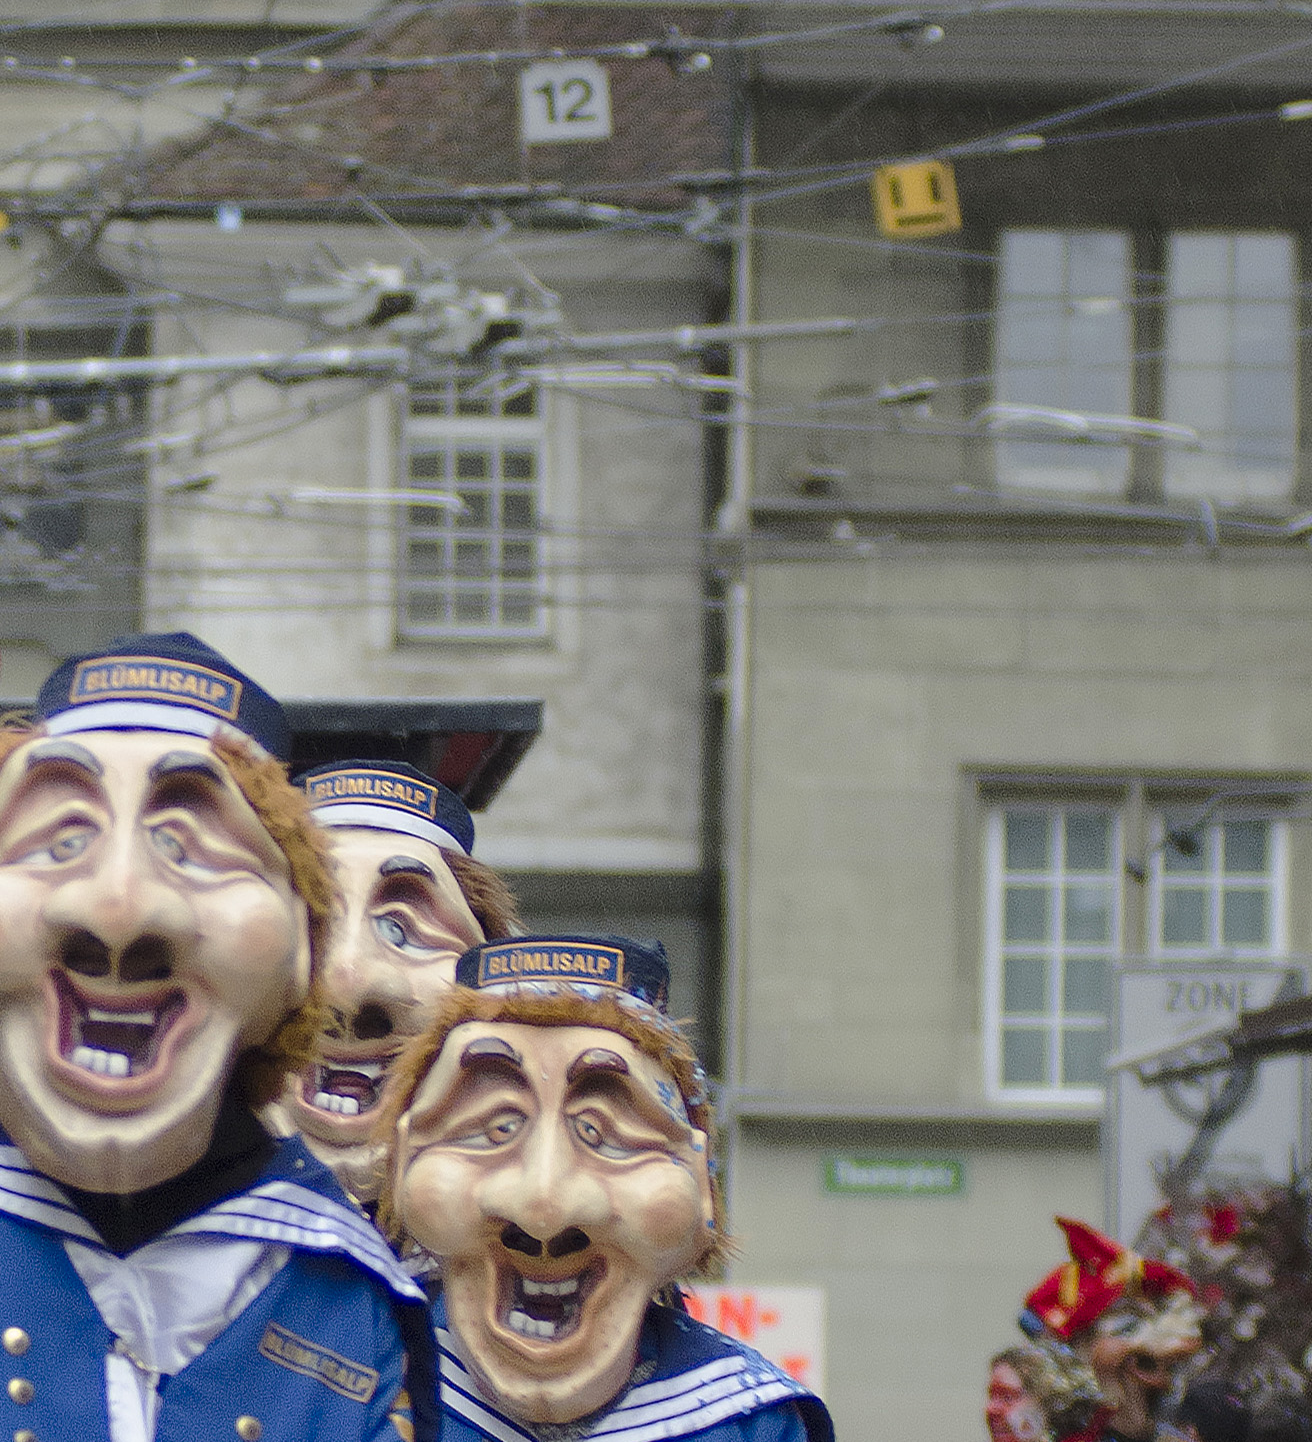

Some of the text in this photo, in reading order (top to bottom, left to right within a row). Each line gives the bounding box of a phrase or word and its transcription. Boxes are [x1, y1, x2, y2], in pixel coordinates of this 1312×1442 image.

[533, 78, 597, 124] 12
[84, 663, 227, 701] BLÜMLISALP
[314, 775, 426, 806] BLÜMLISALP
[489, 950, 611, 975] BLÜMLISALP
[1165, 980, 1253, 1013] ZONE
